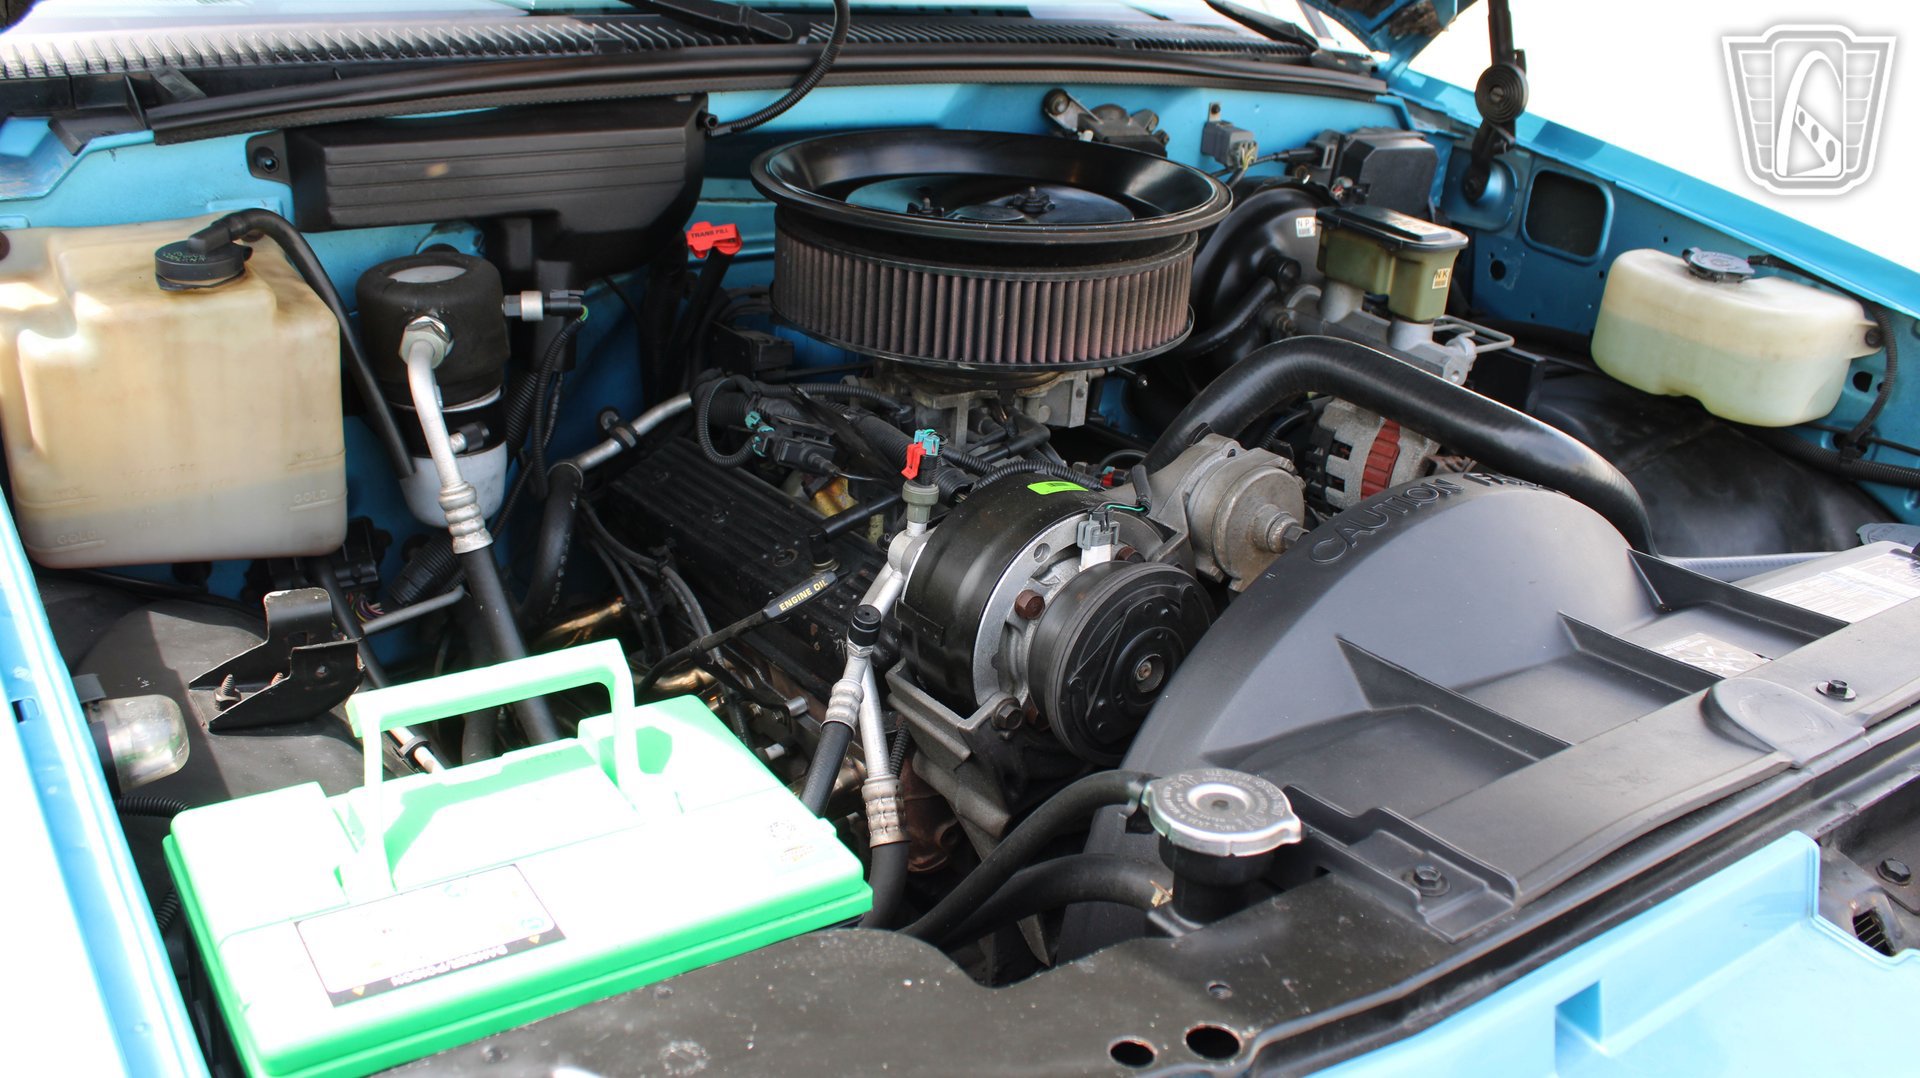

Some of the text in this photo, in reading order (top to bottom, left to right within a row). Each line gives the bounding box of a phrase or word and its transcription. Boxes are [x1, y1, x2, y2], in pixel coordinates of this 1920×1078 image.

[690, 230, 714, 239] TRANS
[1310, 477, 1466, 564] CAUTION
[778, 579, 829, 612] ENGINE OIL
